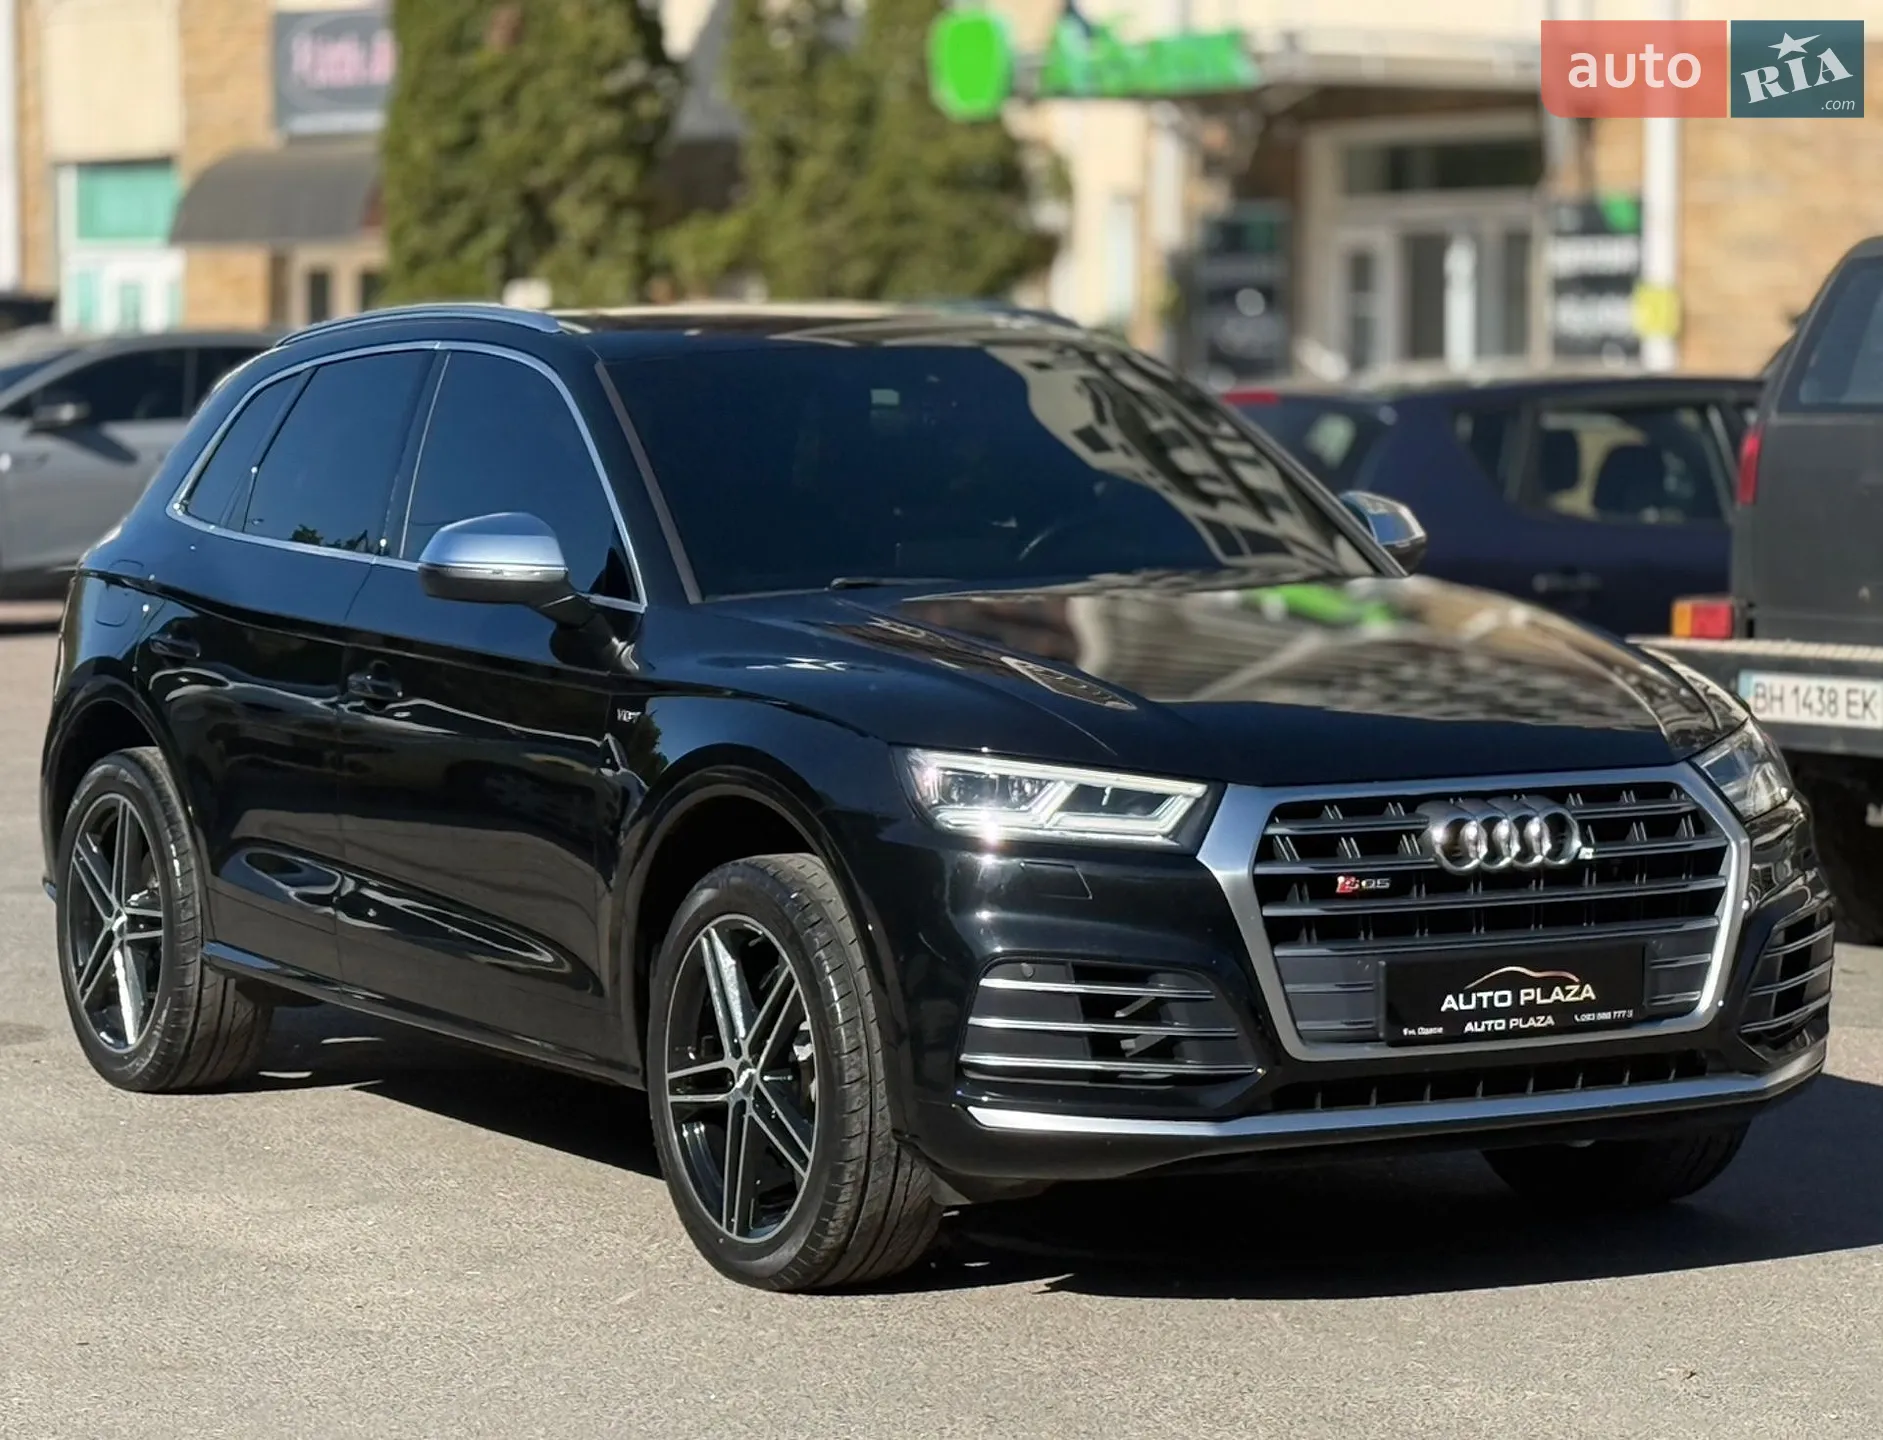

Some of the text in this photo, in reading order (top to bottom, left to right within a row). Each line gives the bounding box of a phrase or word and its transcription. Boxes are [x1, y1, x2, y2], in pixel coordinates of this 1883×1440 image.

[1753, 682, 1878, 721] BH 1438 EK
[1440, 983, 1597, 1012] AUTO PLAZA
[1463, 1014, 1555, 1034] AUTO PLAZA
